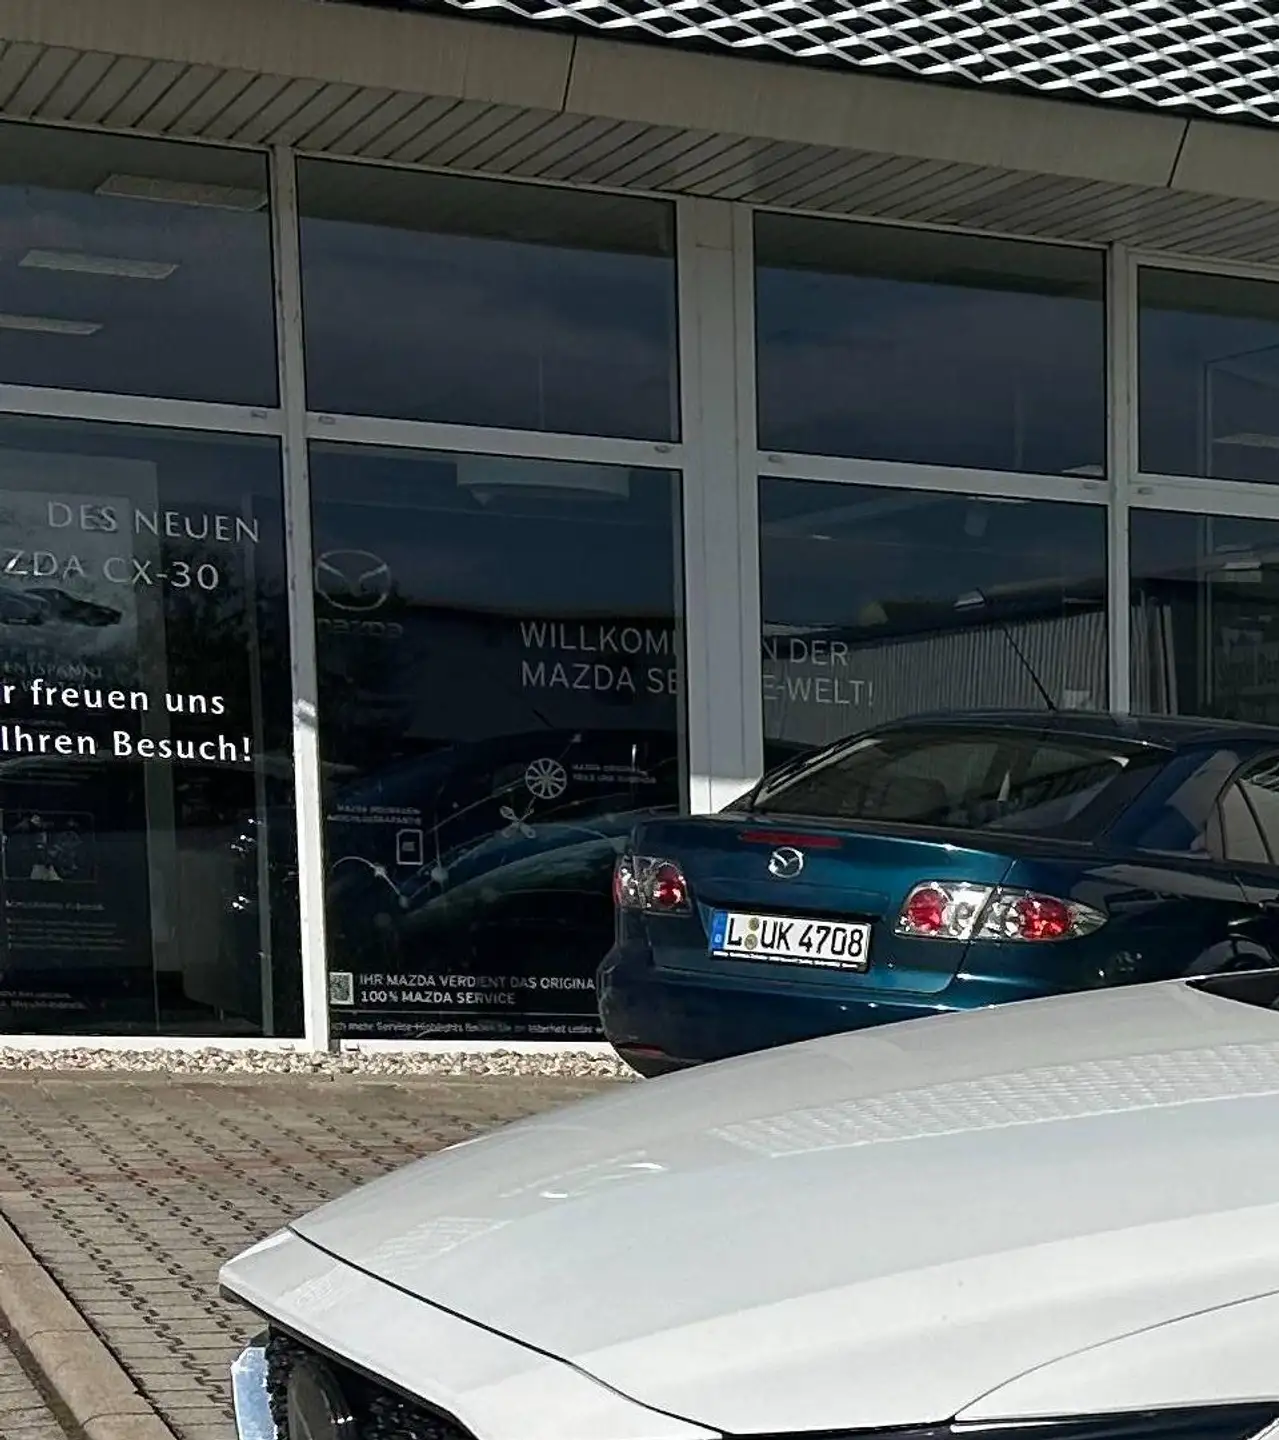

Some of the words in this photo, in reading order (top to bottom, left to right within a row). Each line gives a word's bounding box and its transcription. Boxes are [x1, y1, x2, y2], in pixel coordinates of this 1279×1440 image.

[48, 501, 118, 532] DES
[135, 510, 260, 543] NEUEN
[103, 557, 219, 590] CX-30
[790, 638, 849, 666] DER
[521, 660, 636, 692] MAZDA
[31, 678, 149, 711] freuen
[166, 693, 225, 715] uns
[1, 726, 96, 755] Ihren
[113, 730, 251, 762] Besuch!
[727, 918, 742, 947] L
[761, 920, 795, 951] UK
[799, 924, 864, 957] 4708
[360, 973, 384, 985] IHR
[386, 974, 436, 986] MAZDA
[439, 975, 507, 988] VERDIENT
[510, 976, 537, 989] DAS
[361, 990, 399, 1003] 100%
[401, 991, 454, 1004] MAZDA
[457, 992, 517, 1005] SERVICE
